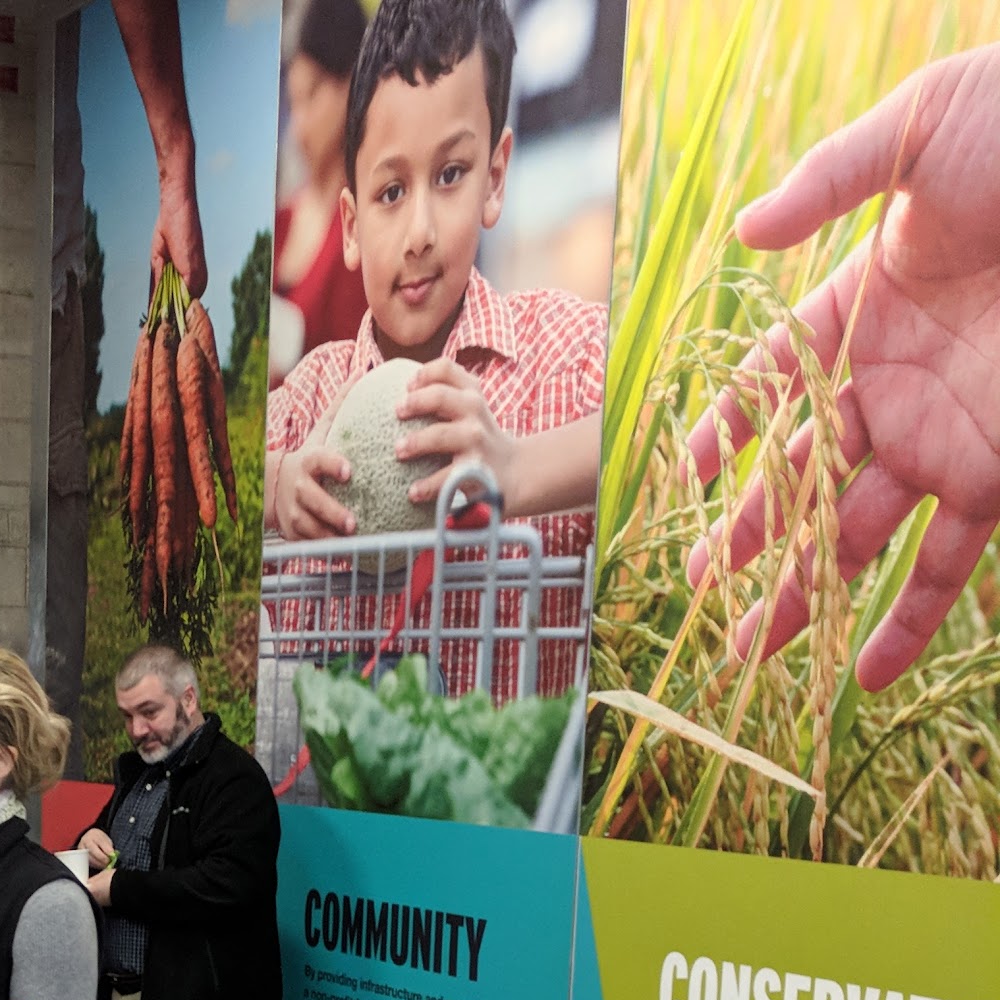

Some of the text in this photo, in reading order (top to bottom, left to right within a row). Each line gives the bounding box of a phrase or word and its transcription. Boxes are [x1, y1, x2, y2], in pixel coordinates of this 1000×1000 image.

[304, 888, 487, 982] COMMUNITY
[304, 964, 315, 980] By
[317, 970, 358, 992] providing
